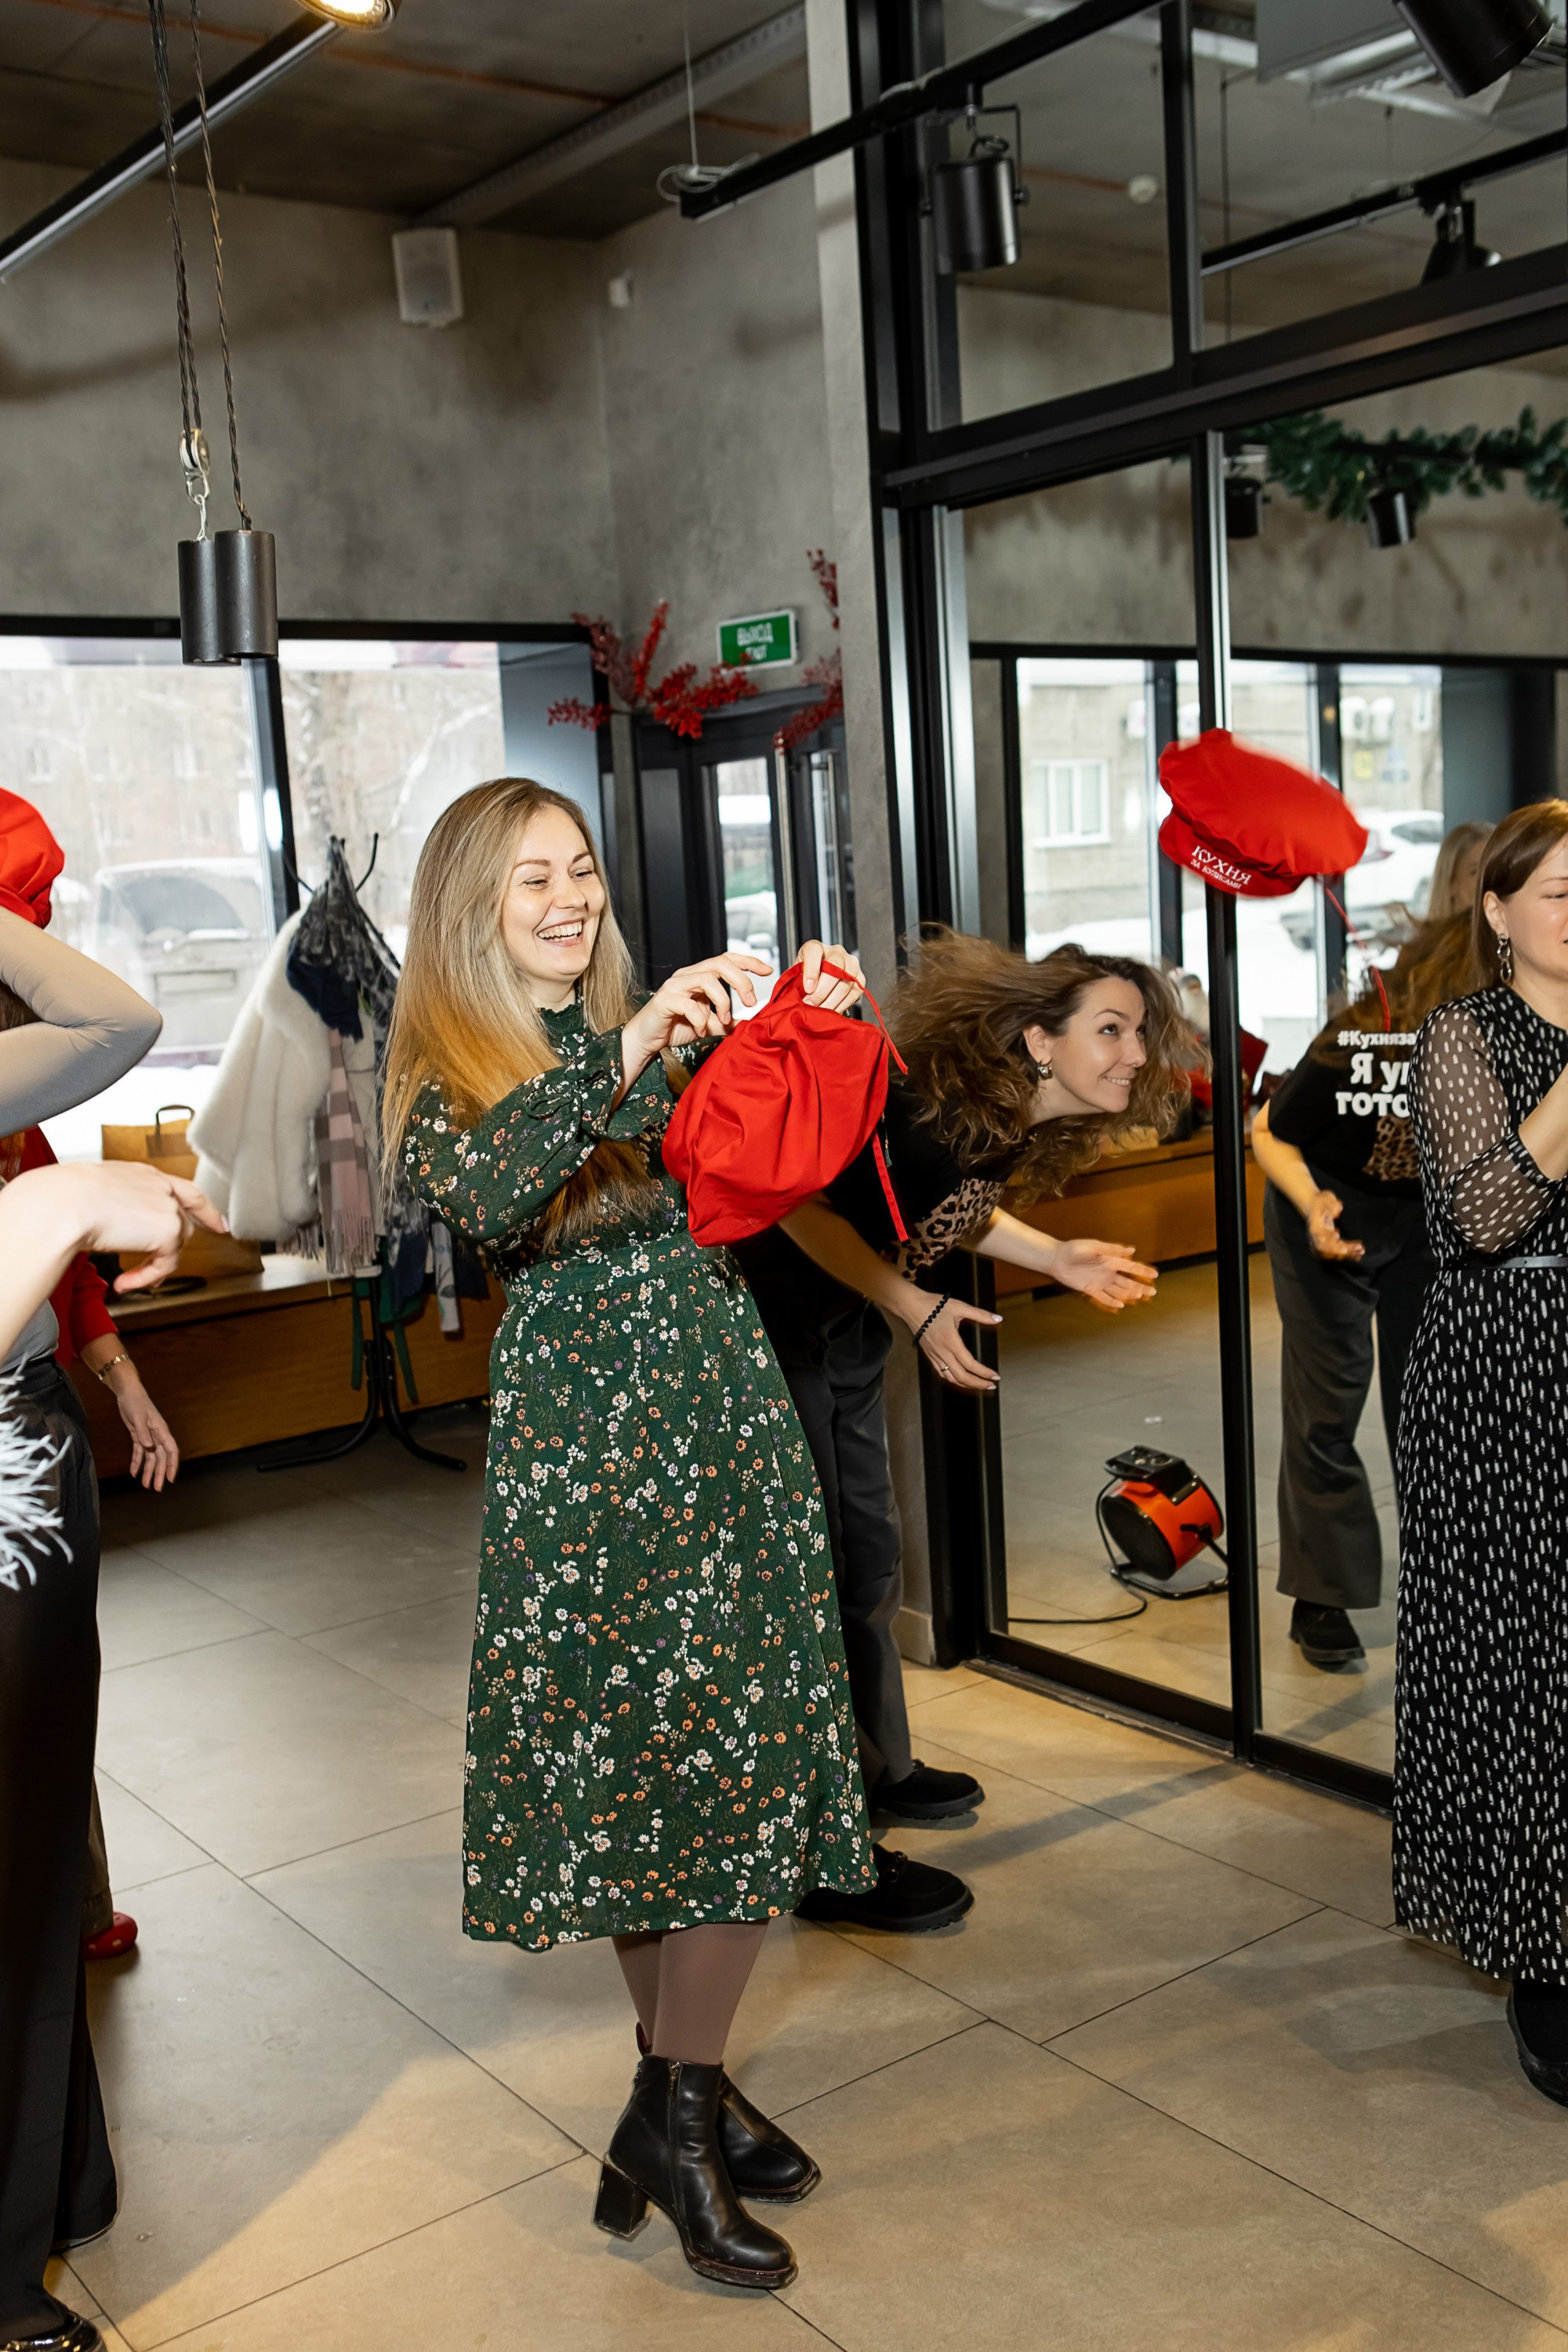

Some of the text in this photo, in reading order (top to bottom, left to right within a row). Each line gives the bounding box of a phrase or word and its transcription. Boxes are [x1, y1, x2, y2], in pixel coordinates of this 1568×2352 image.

[737, 622, 774, 647] ВЫХОД
[1190, 858, 1241, 889] ЗА КУЛИСАМИ
[1192, 845, 1252, 884] КУХНЯ
[1350, 1052, 1374, 1084] Я
